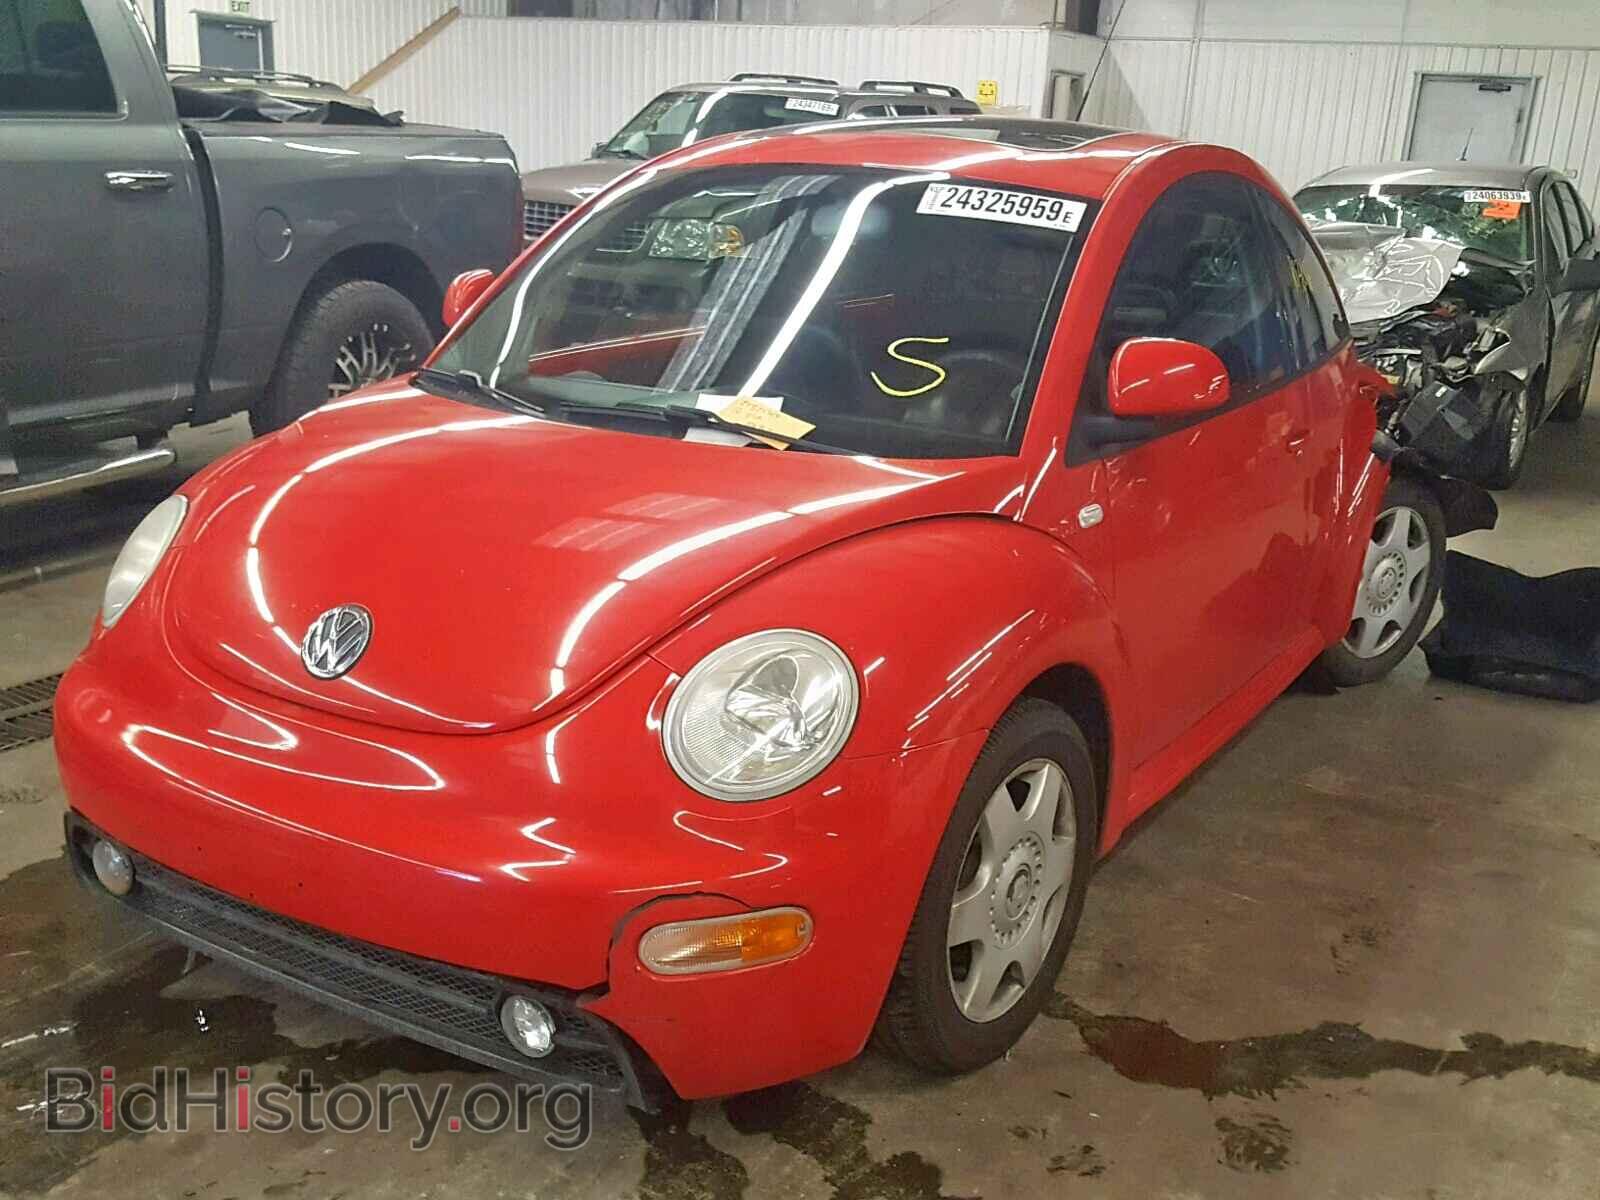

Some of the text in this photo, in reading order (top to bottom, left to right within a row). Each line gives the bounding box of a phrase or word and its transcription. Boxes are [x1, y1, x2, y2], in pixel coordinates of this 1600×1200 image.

[940, 187, 1064, 222] 24325959
[1472, 190, 1521, 200] 24063939
[870, 337, 949, 397] S
